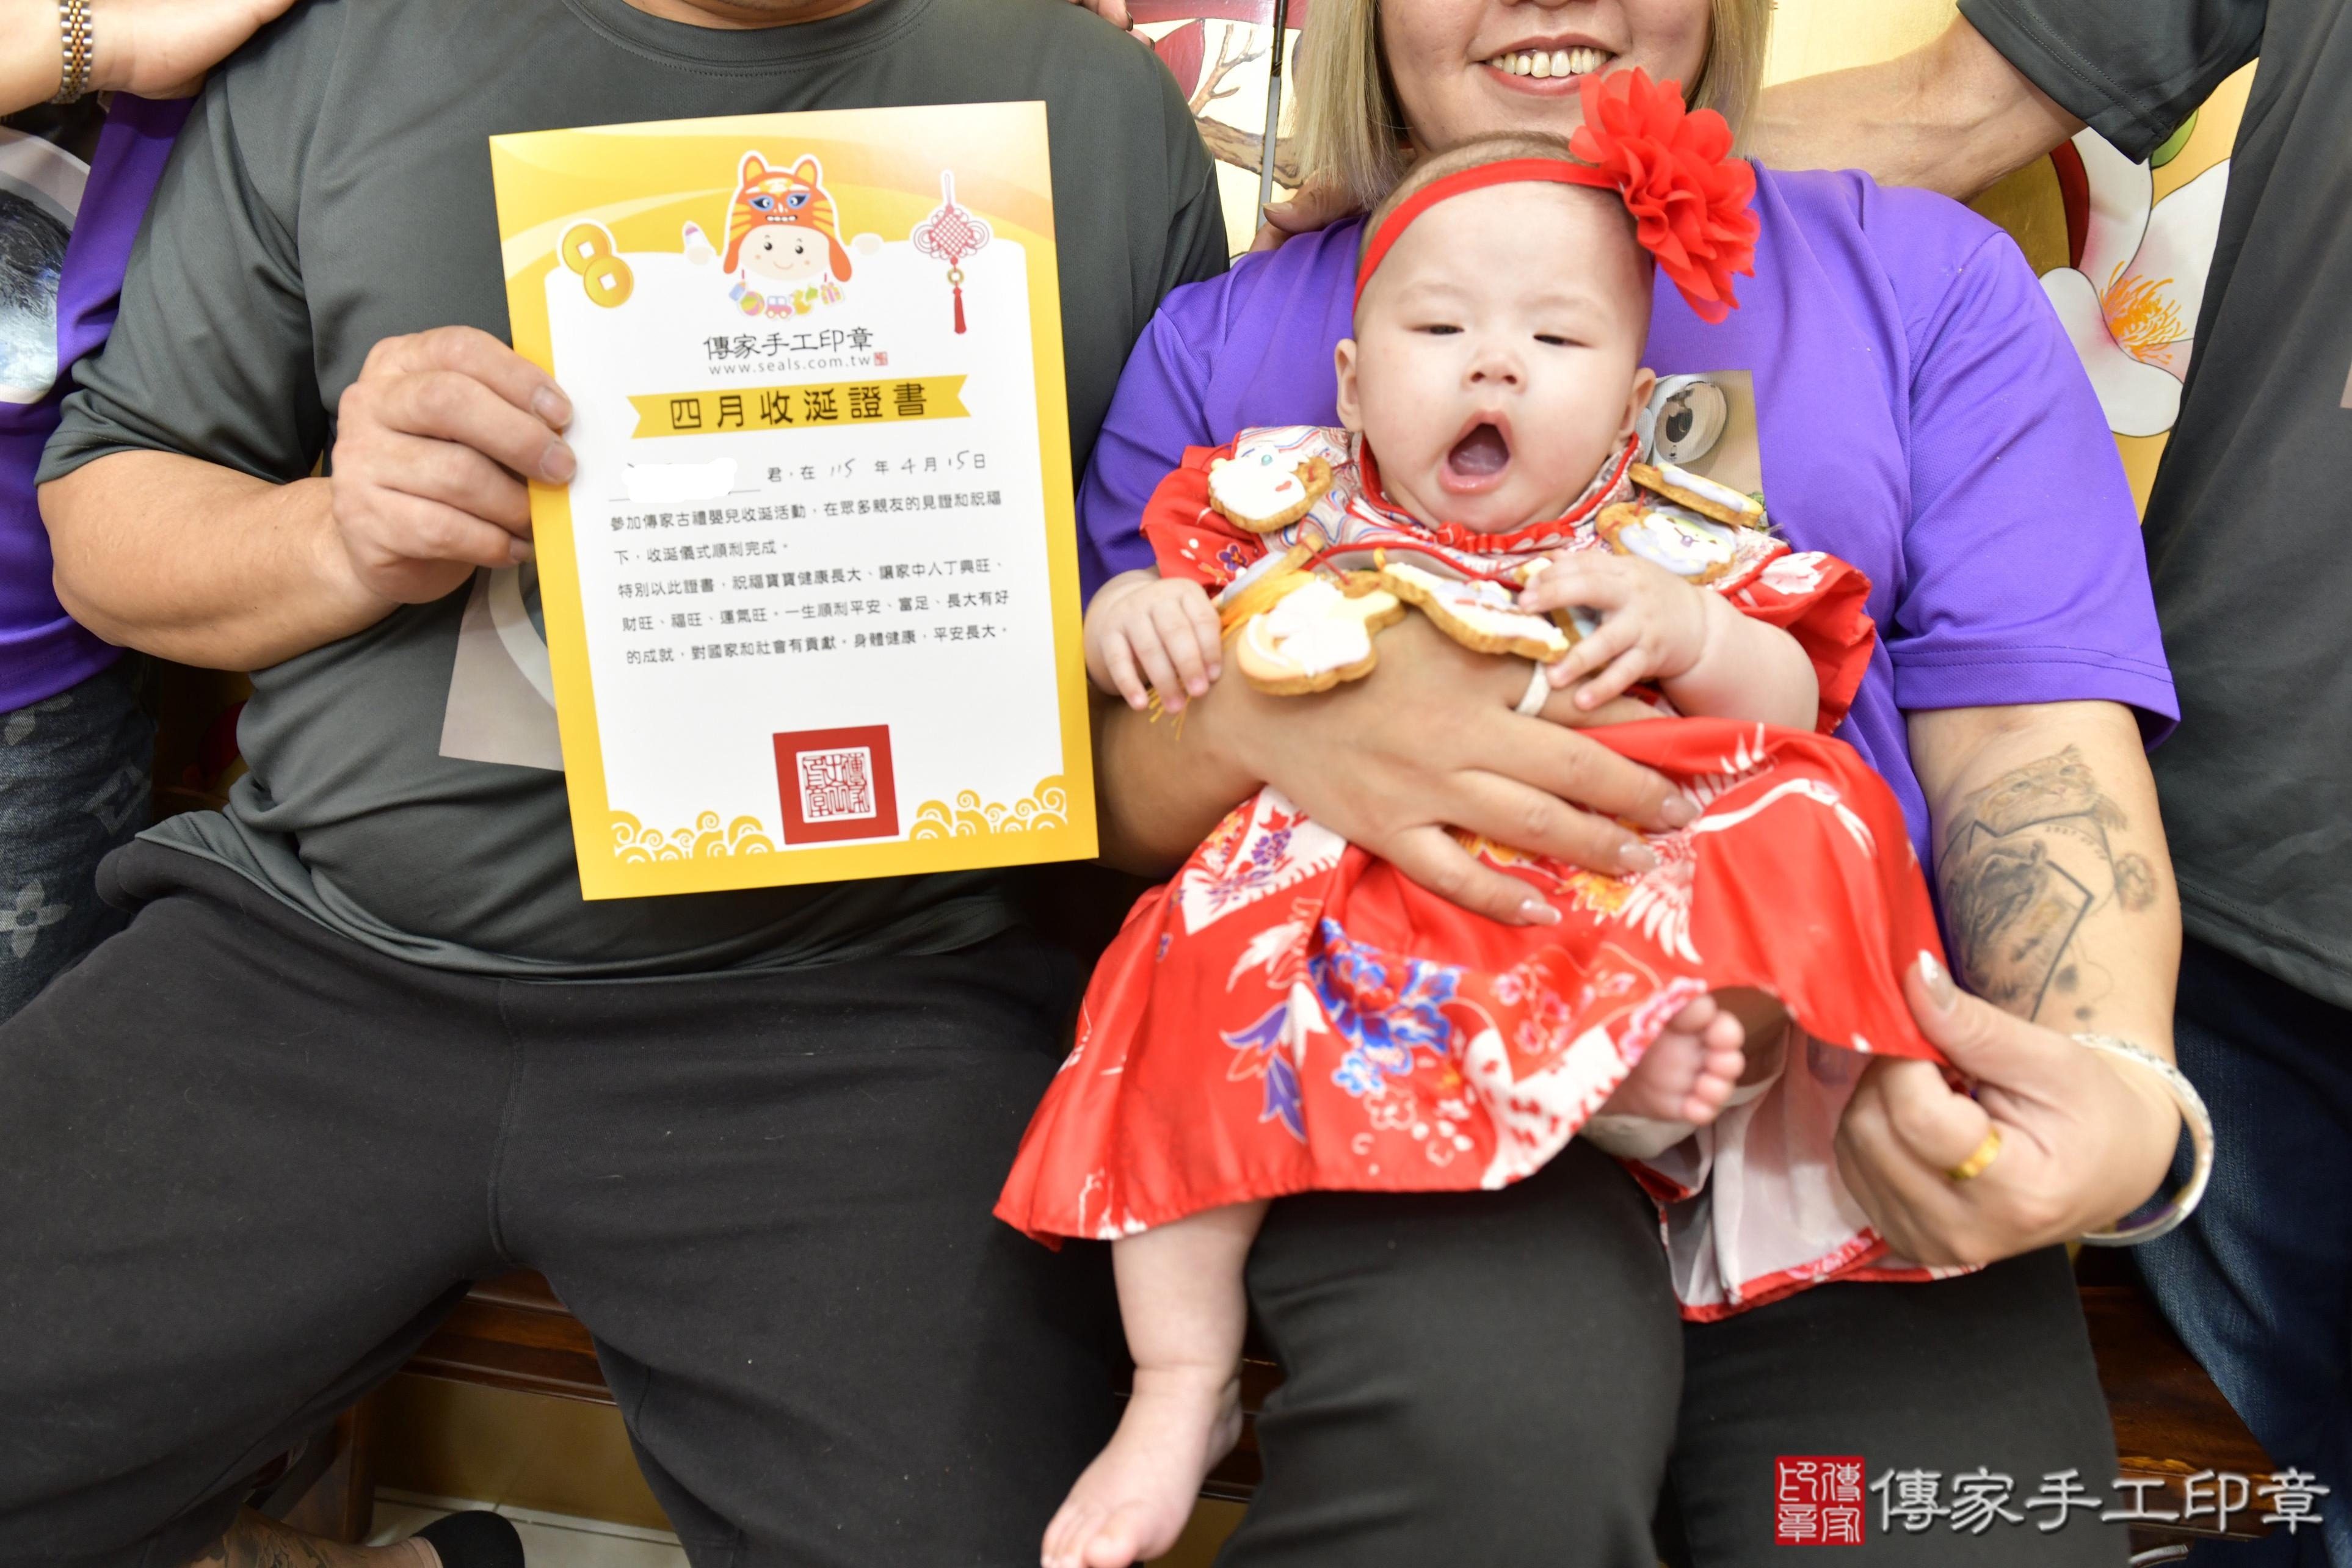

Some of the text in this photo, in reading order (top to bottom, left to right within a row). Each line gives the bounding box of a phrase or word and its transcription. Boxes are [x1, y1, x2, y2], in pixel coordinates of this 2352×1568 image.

[703, 326, 874, 360] 傳家手工印章
[709, 352, 871, 375] www.seals.com.tw
[670, 382, 927, 429] 四月收涎證書
[874, 460, 889, 474] 年
[901, 457, 916, 475] 4
[924, 456, 937, 472] 月
[973, 453, 986, 470] 日
